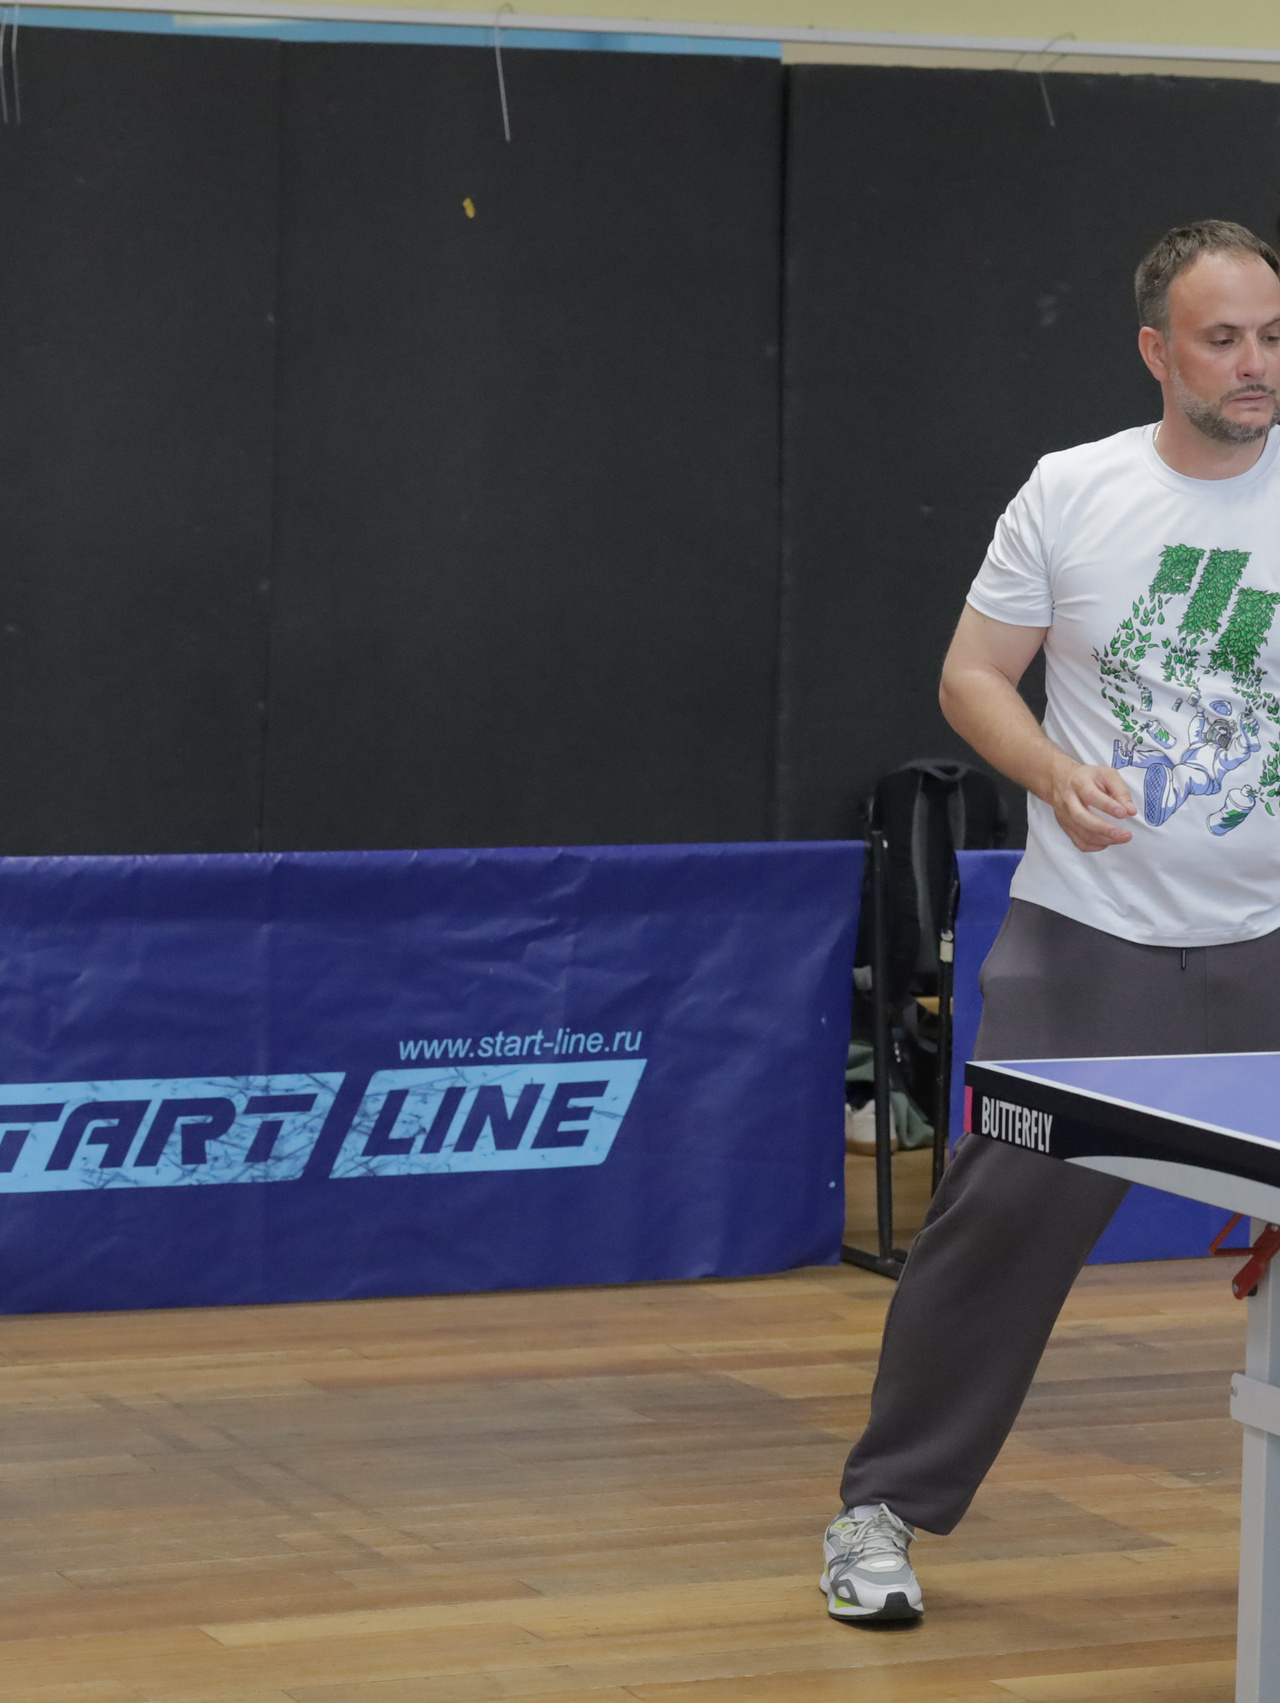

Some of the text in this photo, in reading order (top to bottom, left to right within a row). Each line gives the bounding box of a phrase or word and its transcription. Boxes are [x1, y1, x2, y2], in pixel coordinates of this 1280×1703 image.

[399, 1027, 642, 1061] www.start-line.ru
[0, 1080, 610, 1173] TART LINE
[981, 1095, 1053, 1153] BUTTERFLY
